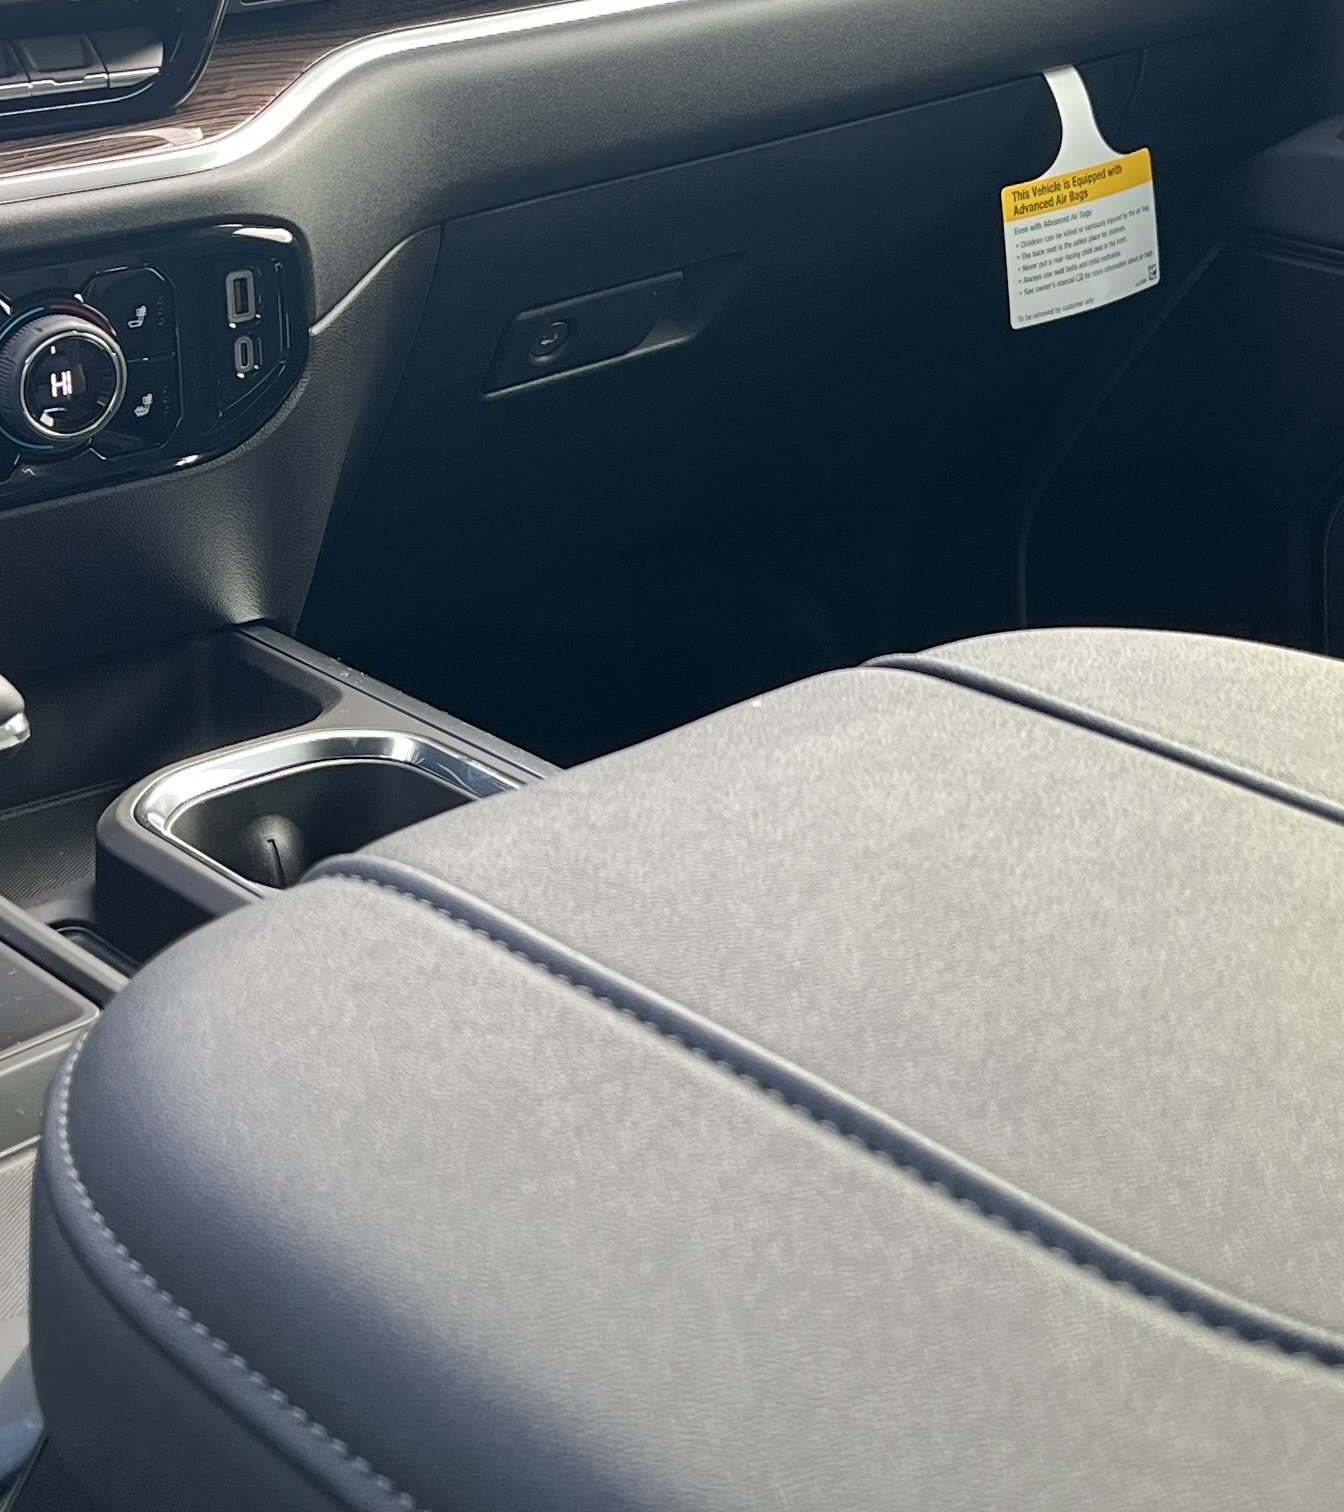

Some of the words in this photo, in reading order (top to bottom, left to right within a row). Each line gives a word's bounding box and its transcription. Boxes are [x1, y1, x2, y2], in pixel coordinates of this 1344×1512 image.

[1011, 189, 1030, 202] This
[1032, 181, 1061, 196] Vehicle
[1063, 179, 1070, 188] is
[1072, 170, 1106, 188] Equipped
[1107, 165, 1122, 176] with
[1014, 197, 1054, 215] Advanced
[1057, 194, 1067, 204] Air
[1069, 188, 1088, 202] Bags
[50, 370, 73, 398] HI
